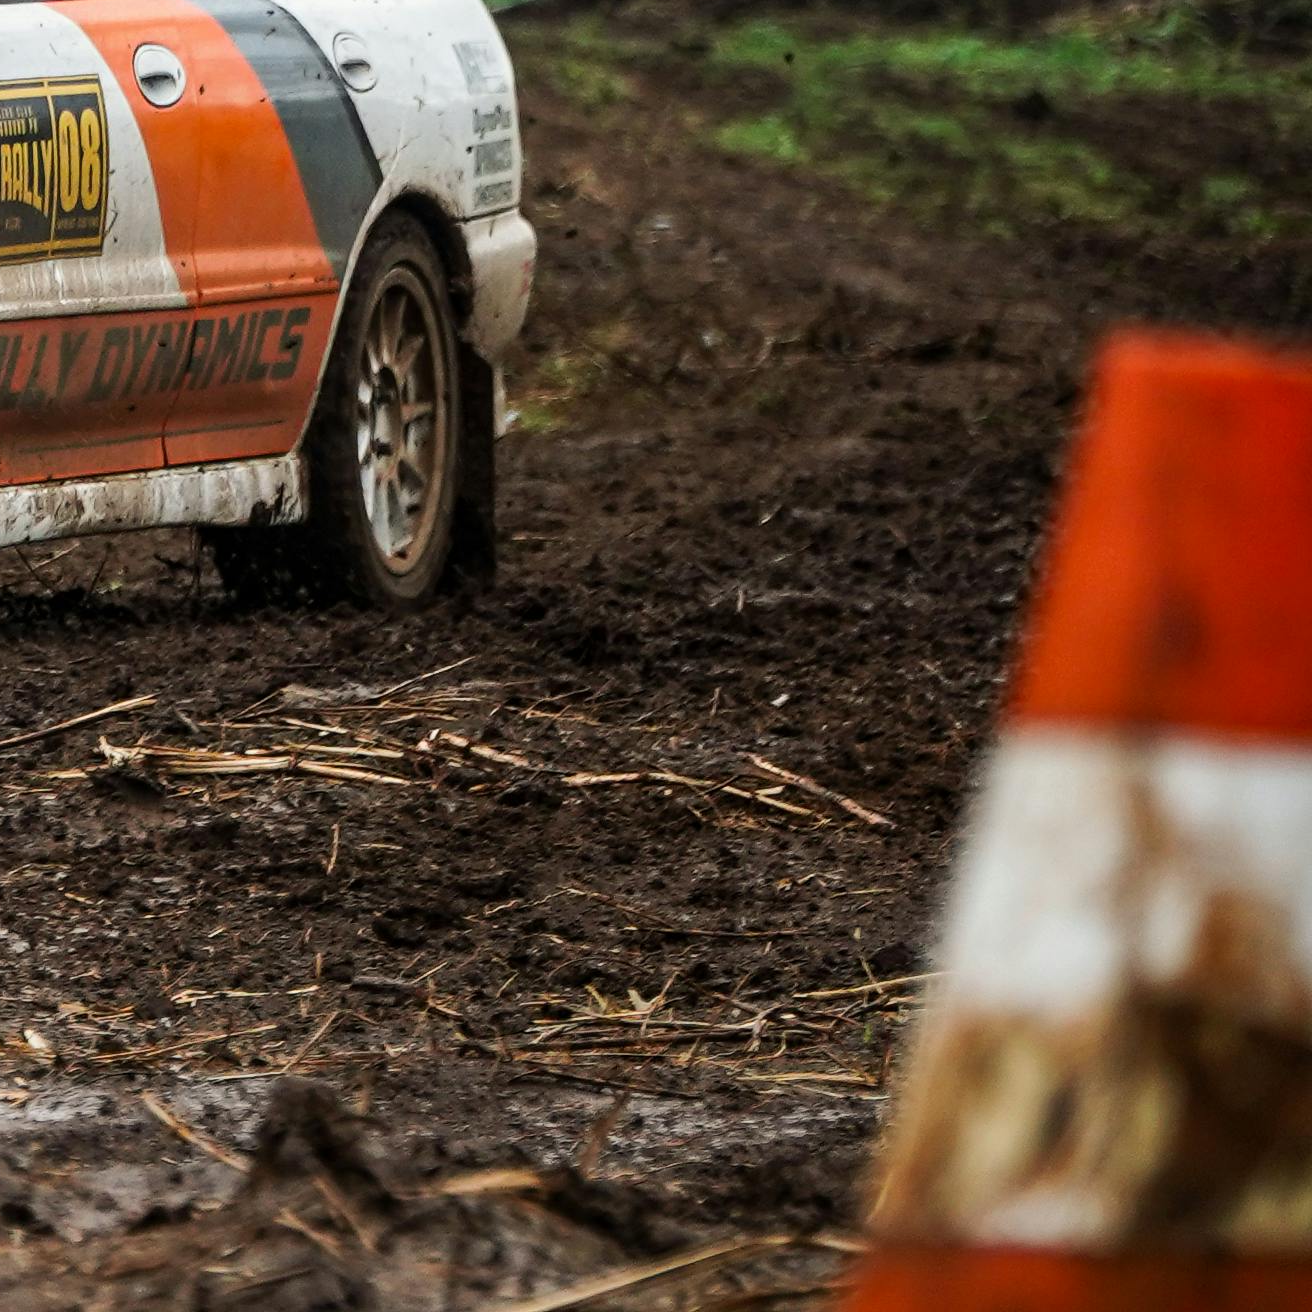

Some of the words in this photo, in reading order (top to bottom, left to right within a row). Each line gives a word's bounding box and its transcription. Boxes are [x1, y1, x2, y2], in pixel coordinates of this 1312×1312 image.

[0, 138, 53, 218] RALLY
[57, 107, 103, 213] 08
[86, 306, 311, 402] DYNAMICS
